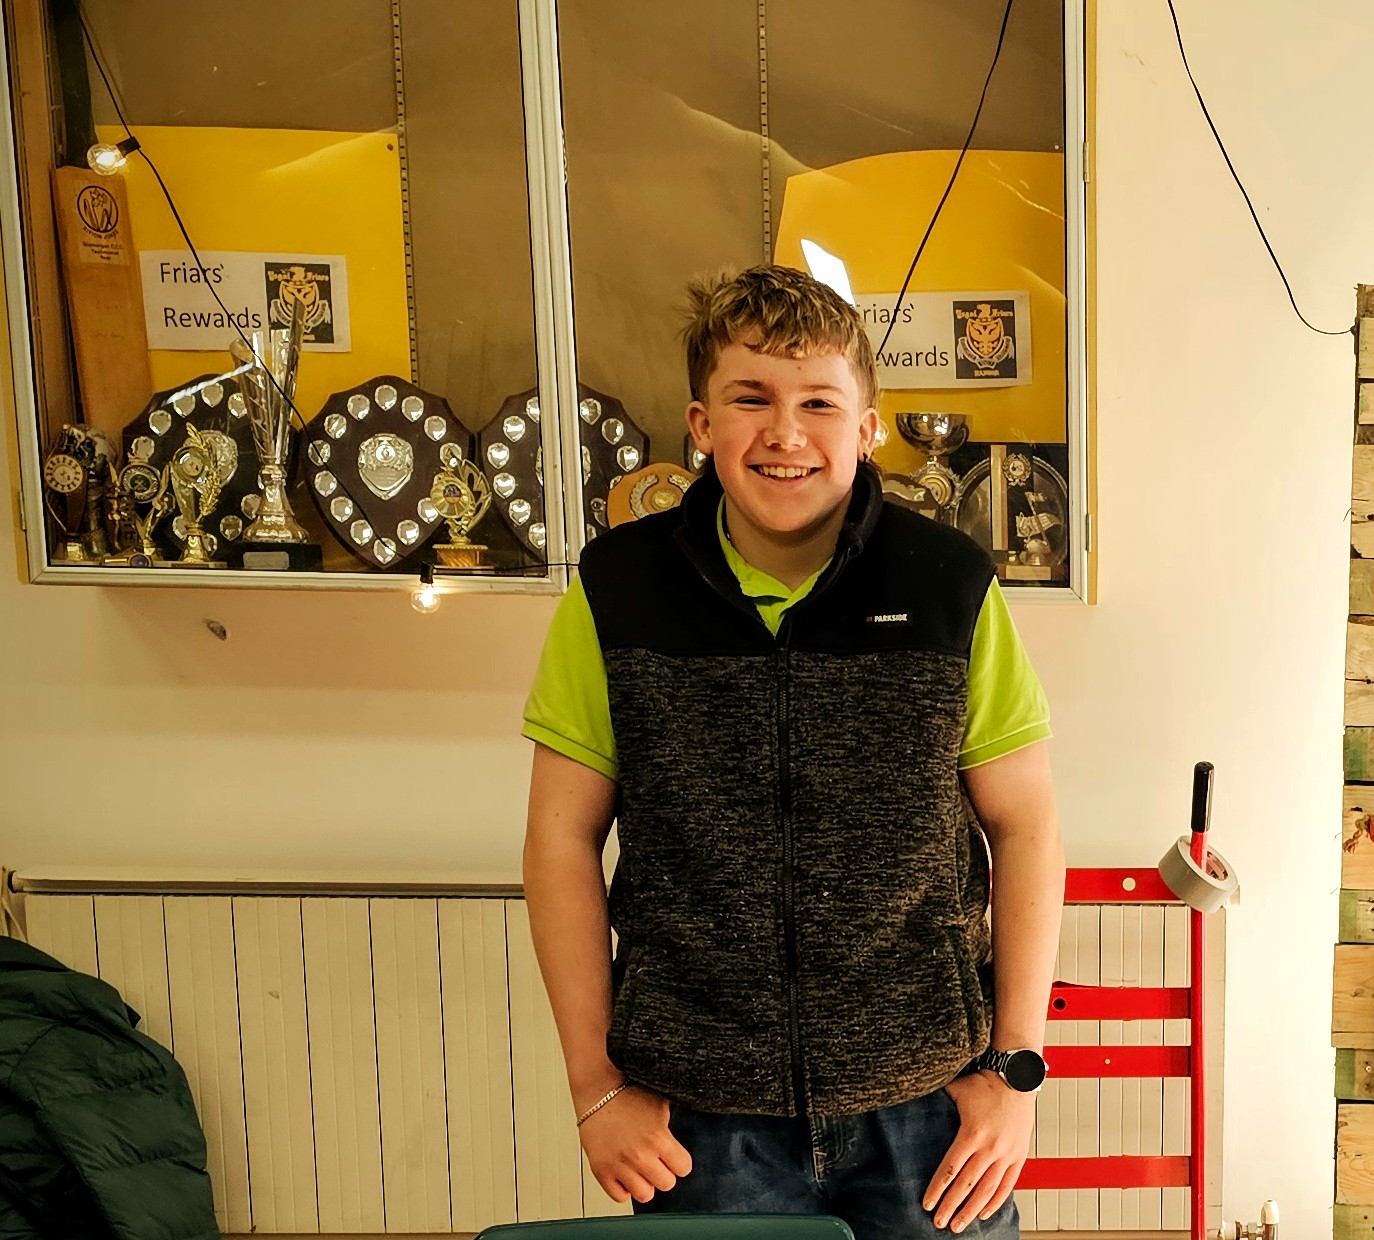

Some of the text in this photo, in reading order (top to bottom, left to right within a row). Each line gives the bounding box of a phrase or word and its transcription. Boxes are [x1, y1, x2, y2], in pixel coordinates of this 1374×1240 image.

[164, 307, 262, 329] Rewards
[854, 303, 914, 324] riars'
[876, 345, 949, 367] wards
[874, 613, 908, 623] PARKSIDE
